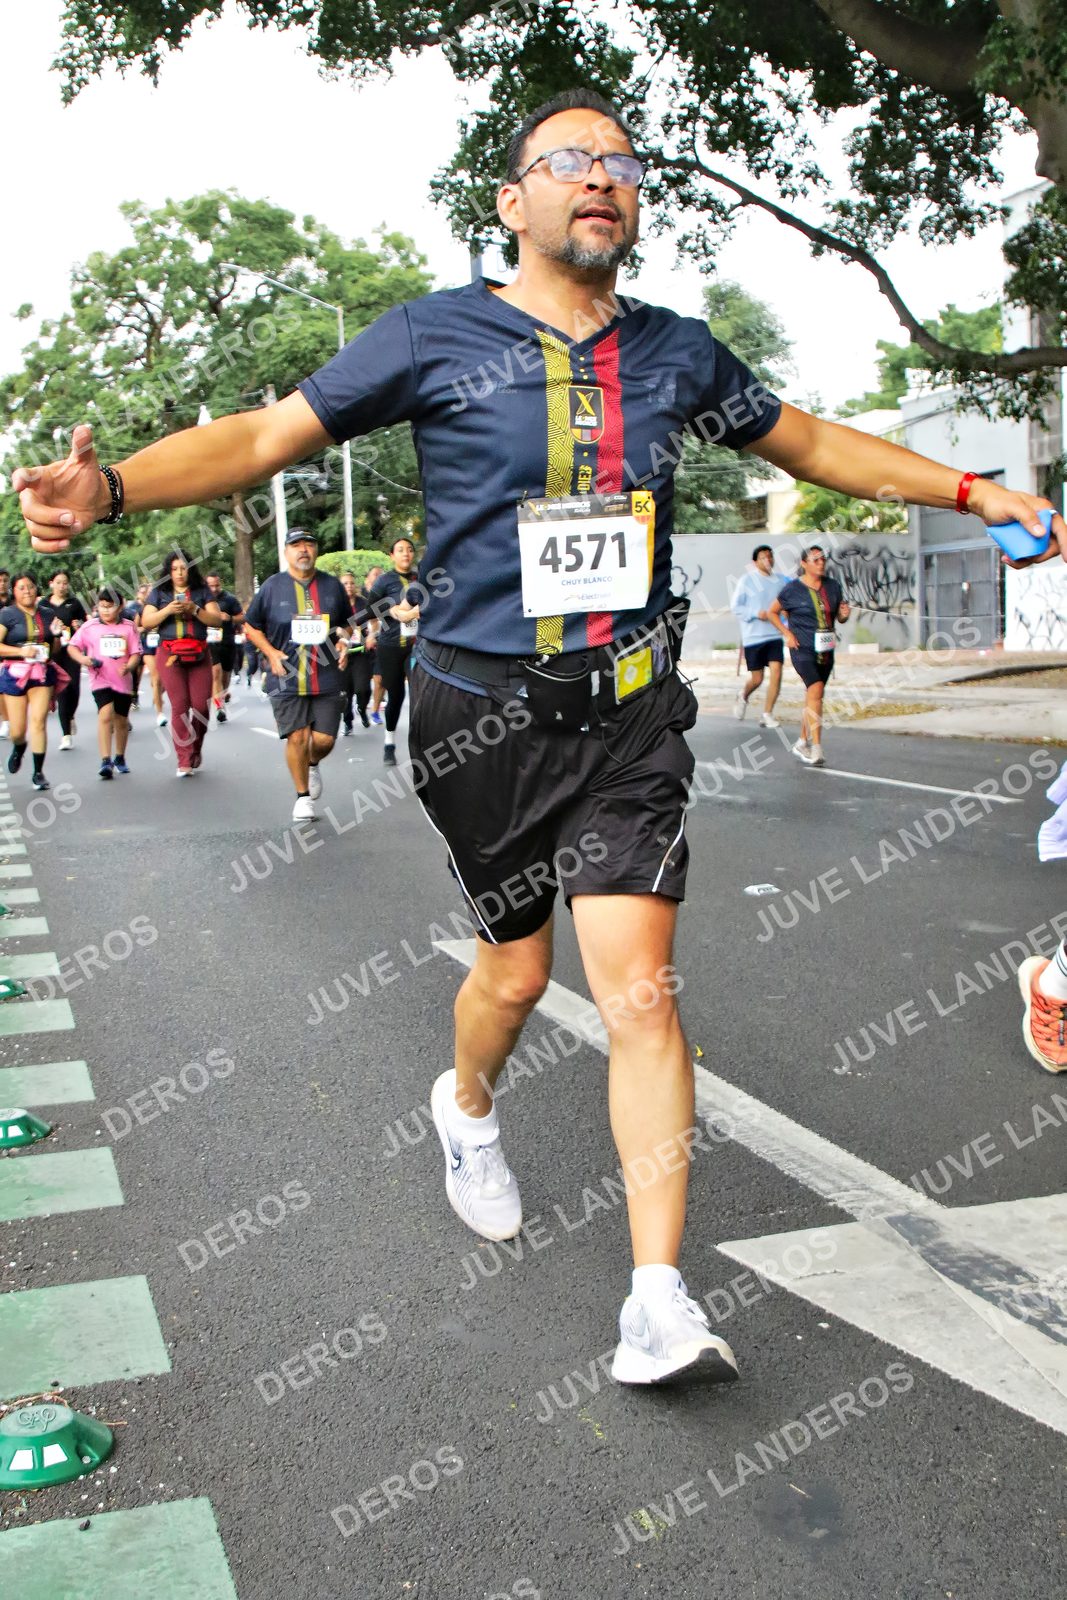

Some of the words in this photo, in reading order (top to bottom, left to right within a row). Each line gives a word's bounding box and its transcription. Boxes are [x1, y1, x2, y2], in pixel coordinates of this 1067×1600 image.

[634, 500, 650, 513] 5K
[539, 532, 626, 573] 4571
[561, 578, 581, 586] CHUY
[583, 576, 613, 585] BLANCO
